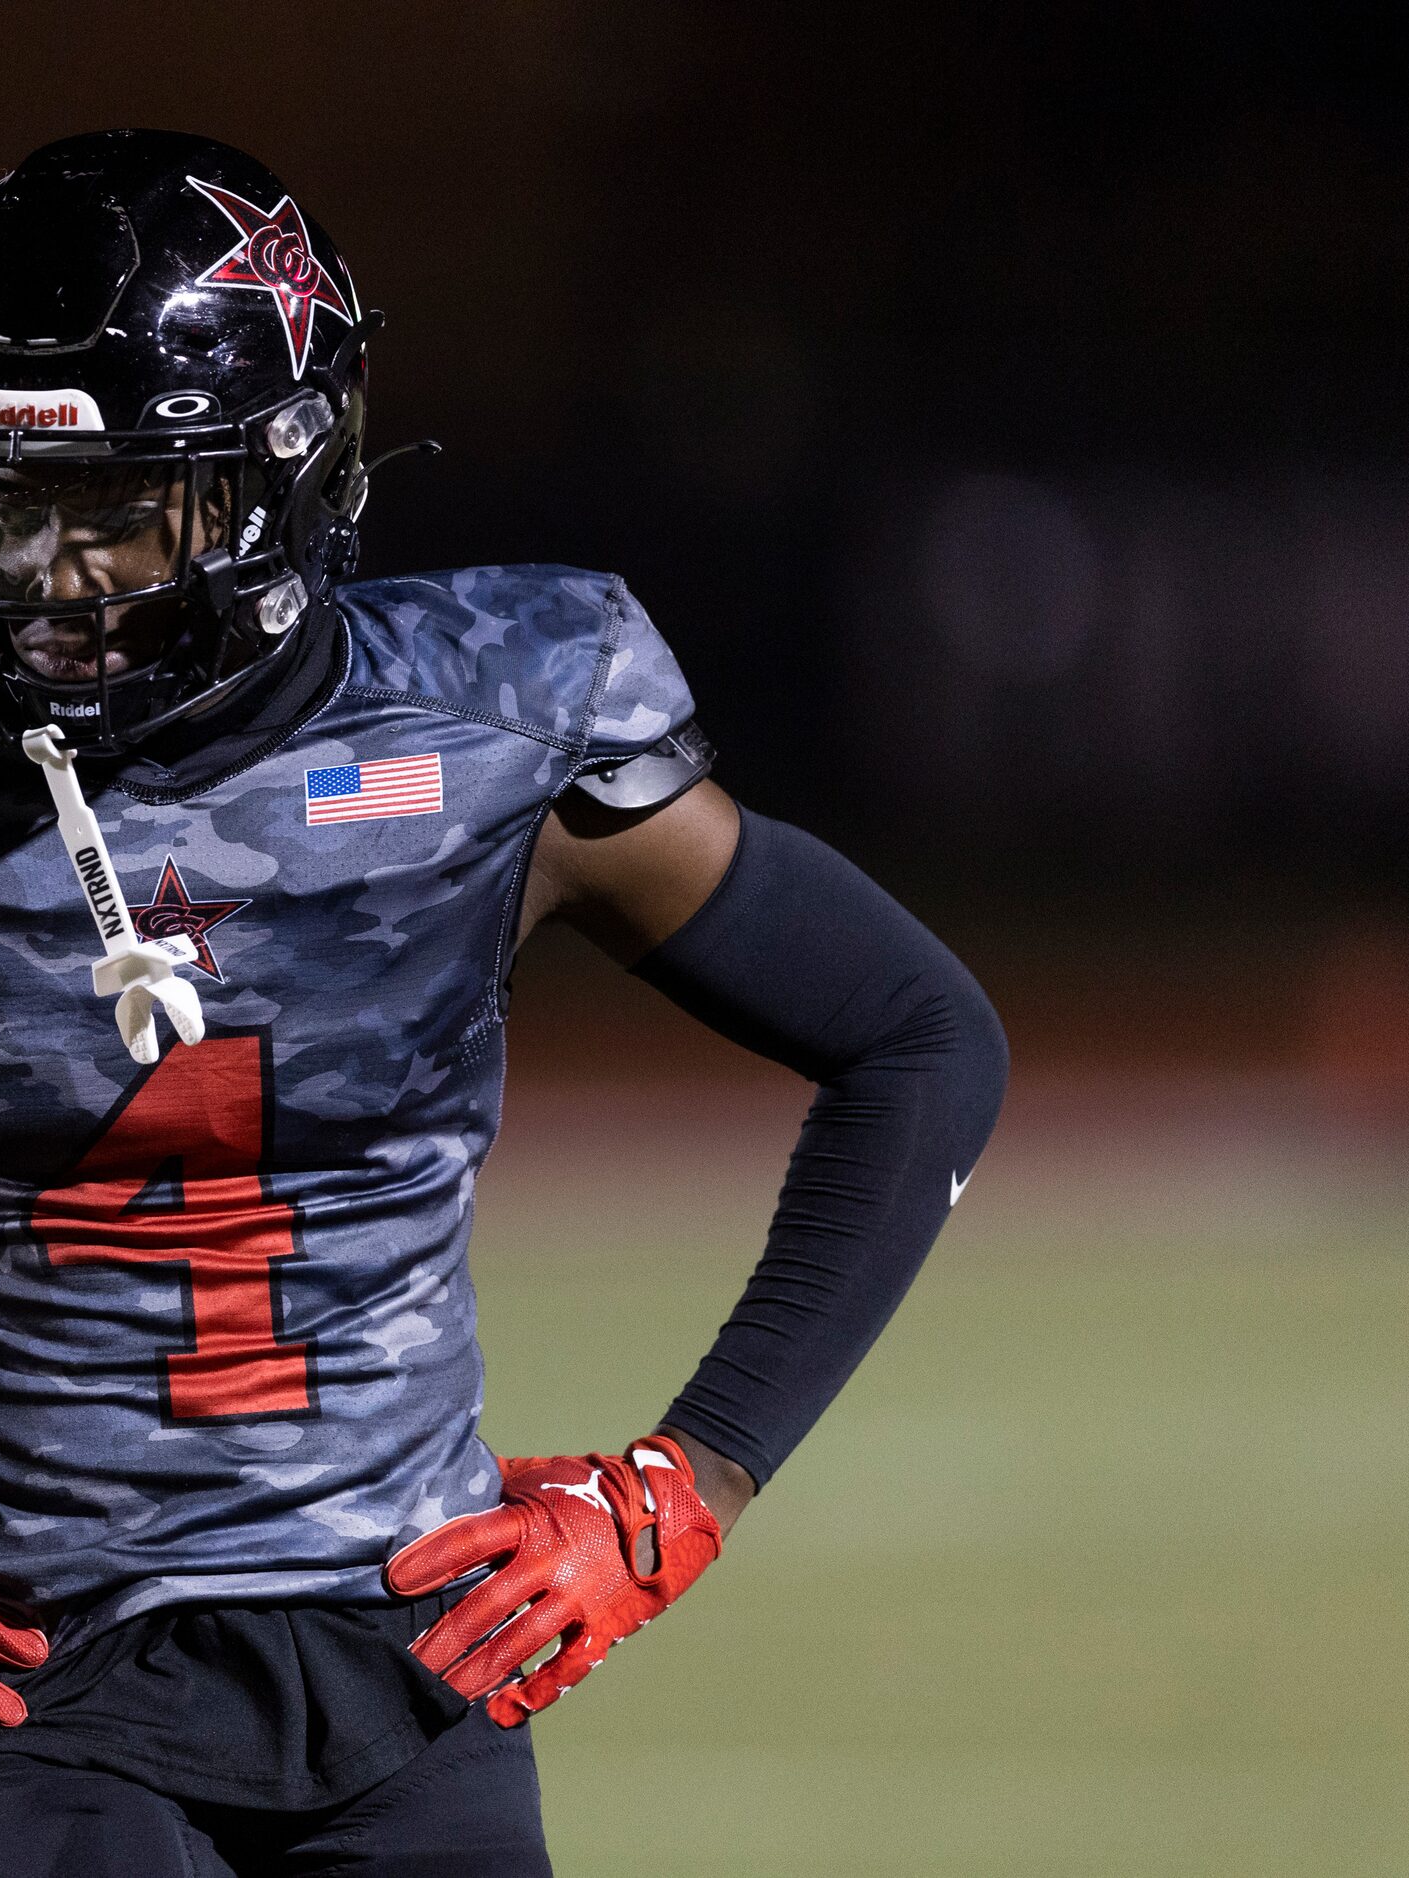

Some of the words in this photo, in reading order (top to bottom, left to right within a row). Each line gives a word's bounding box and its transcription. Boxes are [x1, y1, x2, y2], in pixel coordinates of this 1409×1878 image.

[49, 701, 102, 718] Riddel
[75, 846, 125, 941] NXTRND
[20, 1023, 322, 1430] 4
